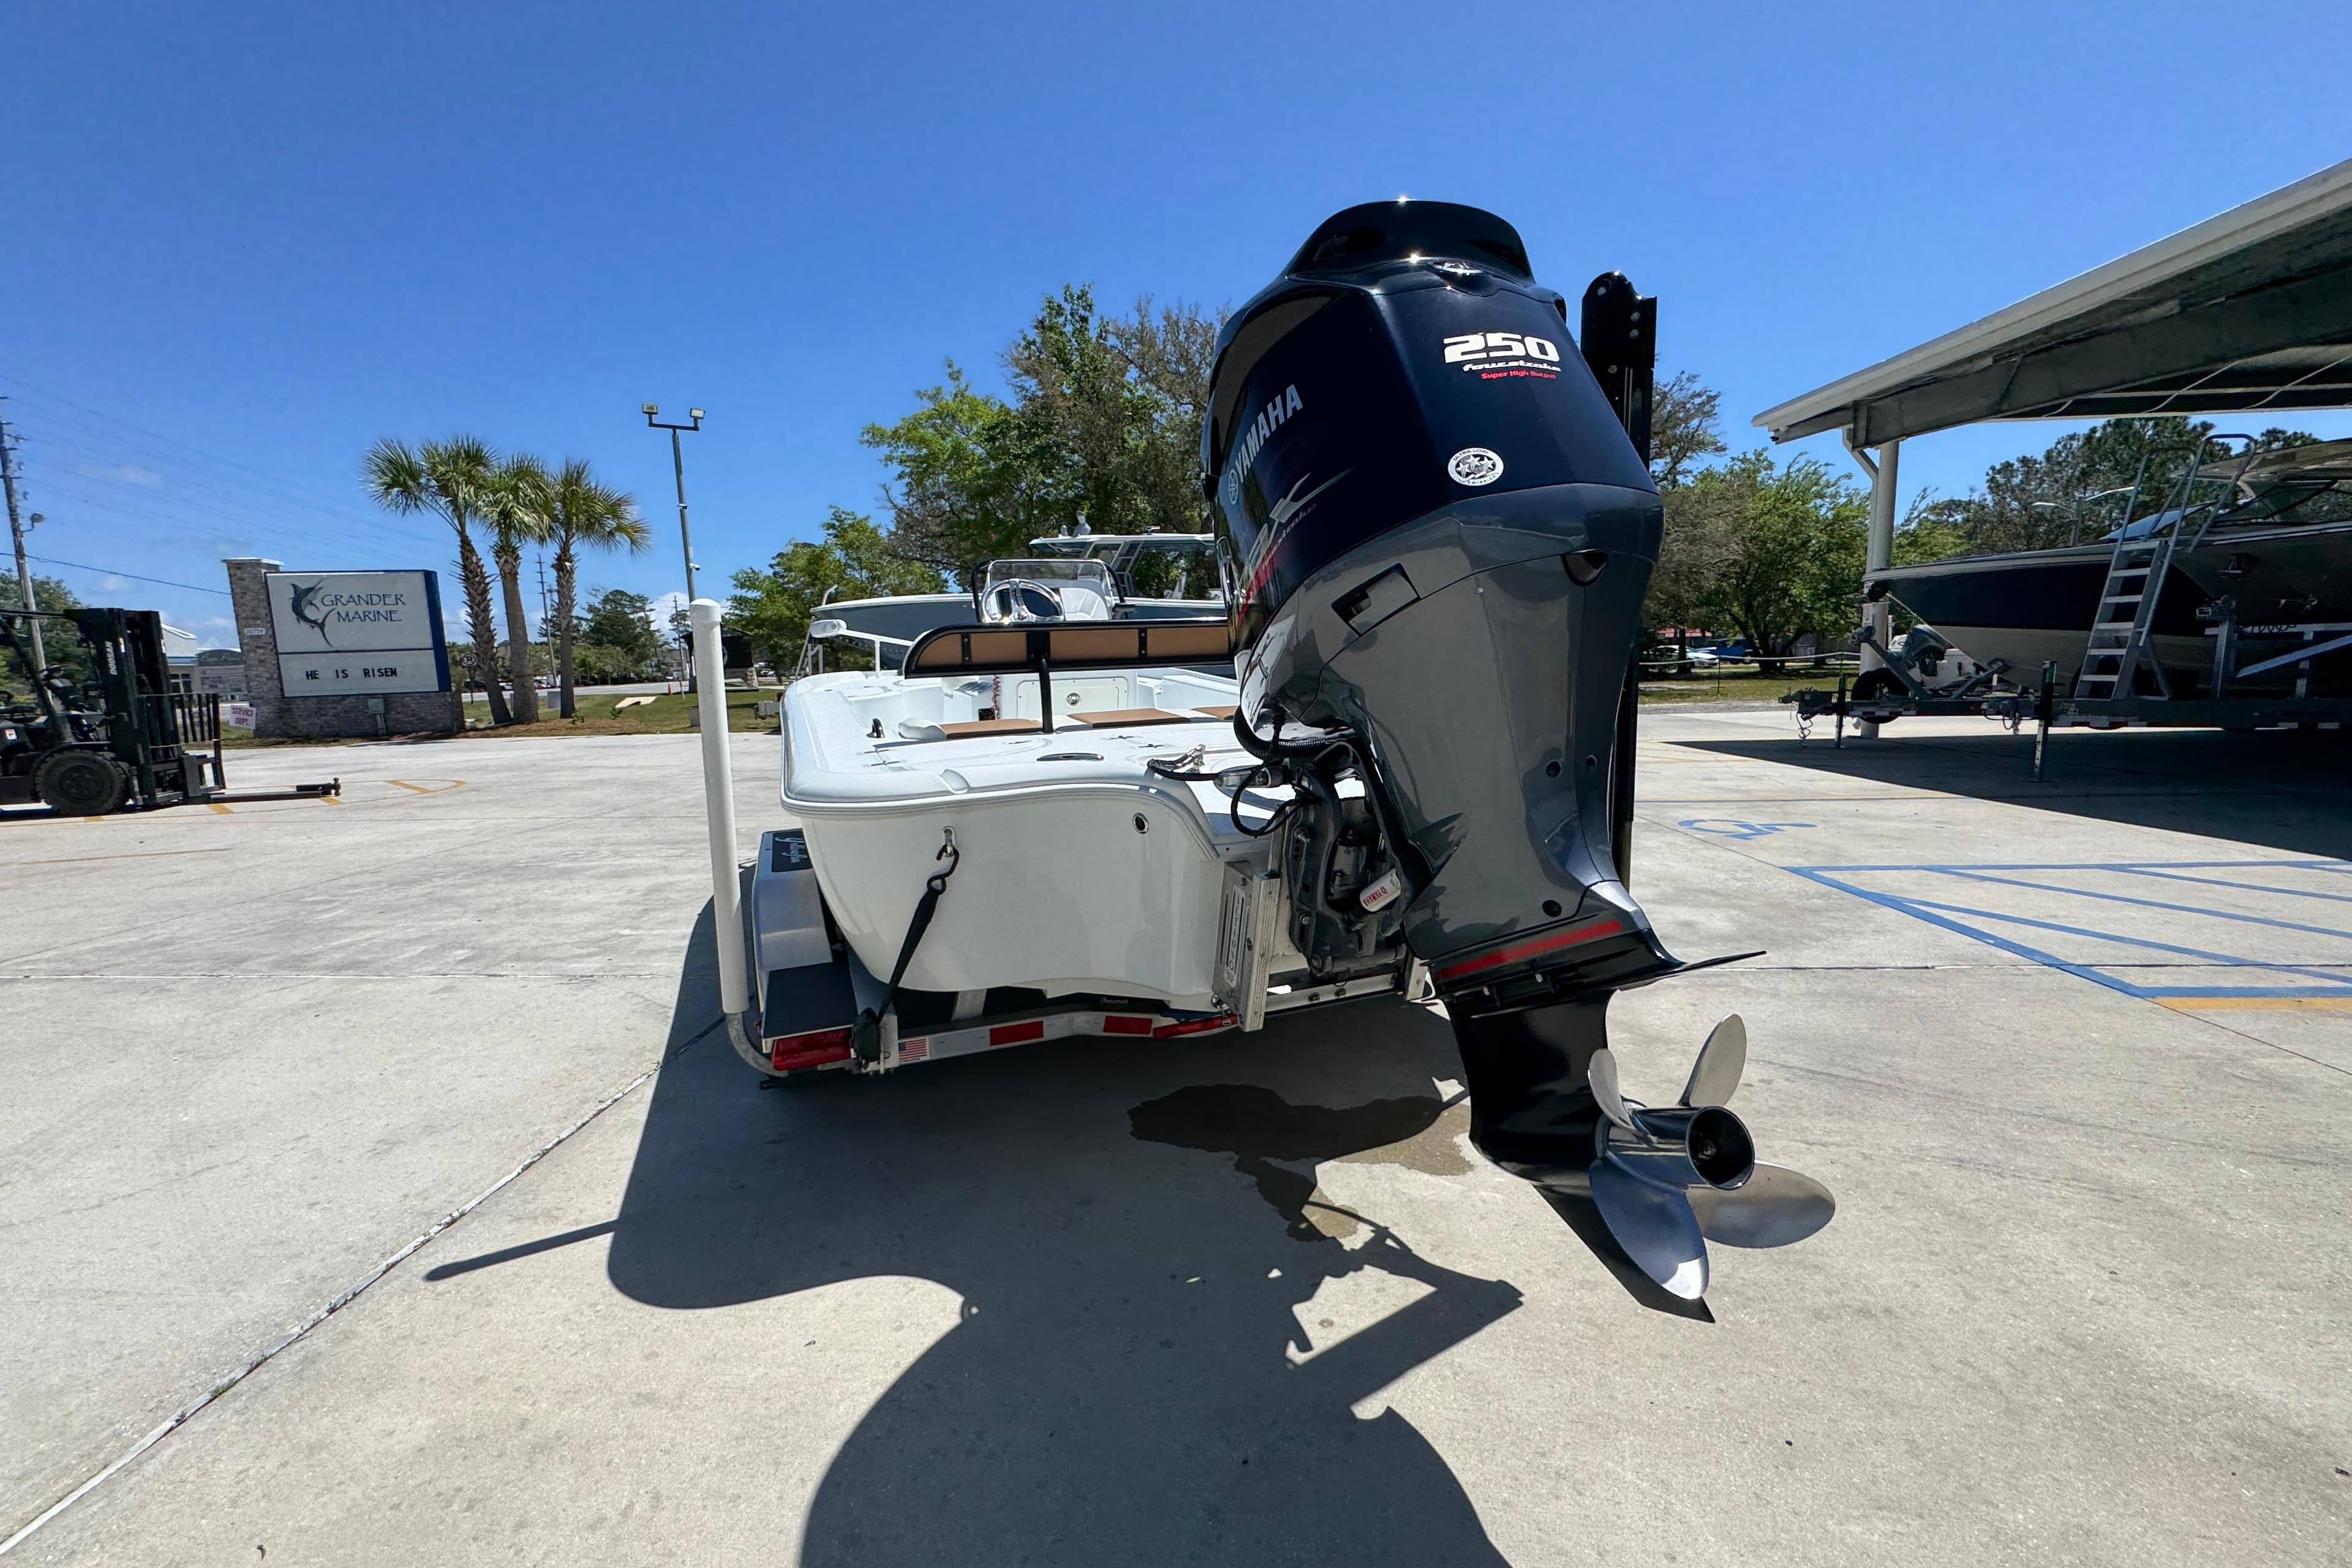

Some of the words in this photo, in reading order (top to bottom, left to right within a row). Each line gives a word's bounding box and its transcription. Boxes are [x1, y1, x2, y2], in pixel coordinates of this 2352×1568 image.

[1443, 332, 1560, 363] 250
[1235, 384, 1303, 483] YAMAHA
[321, 594, 406, 606] GRANDER
[337, 609, 402, 623] MARINE
[104, 641, 118, 676] DOOSAN
[306, 670, 319, 680] HE
[336, 669, 349, 679] IS
[363, 667, 398, 677] RISEN
[232, 707, 254, 716] SERVICE
